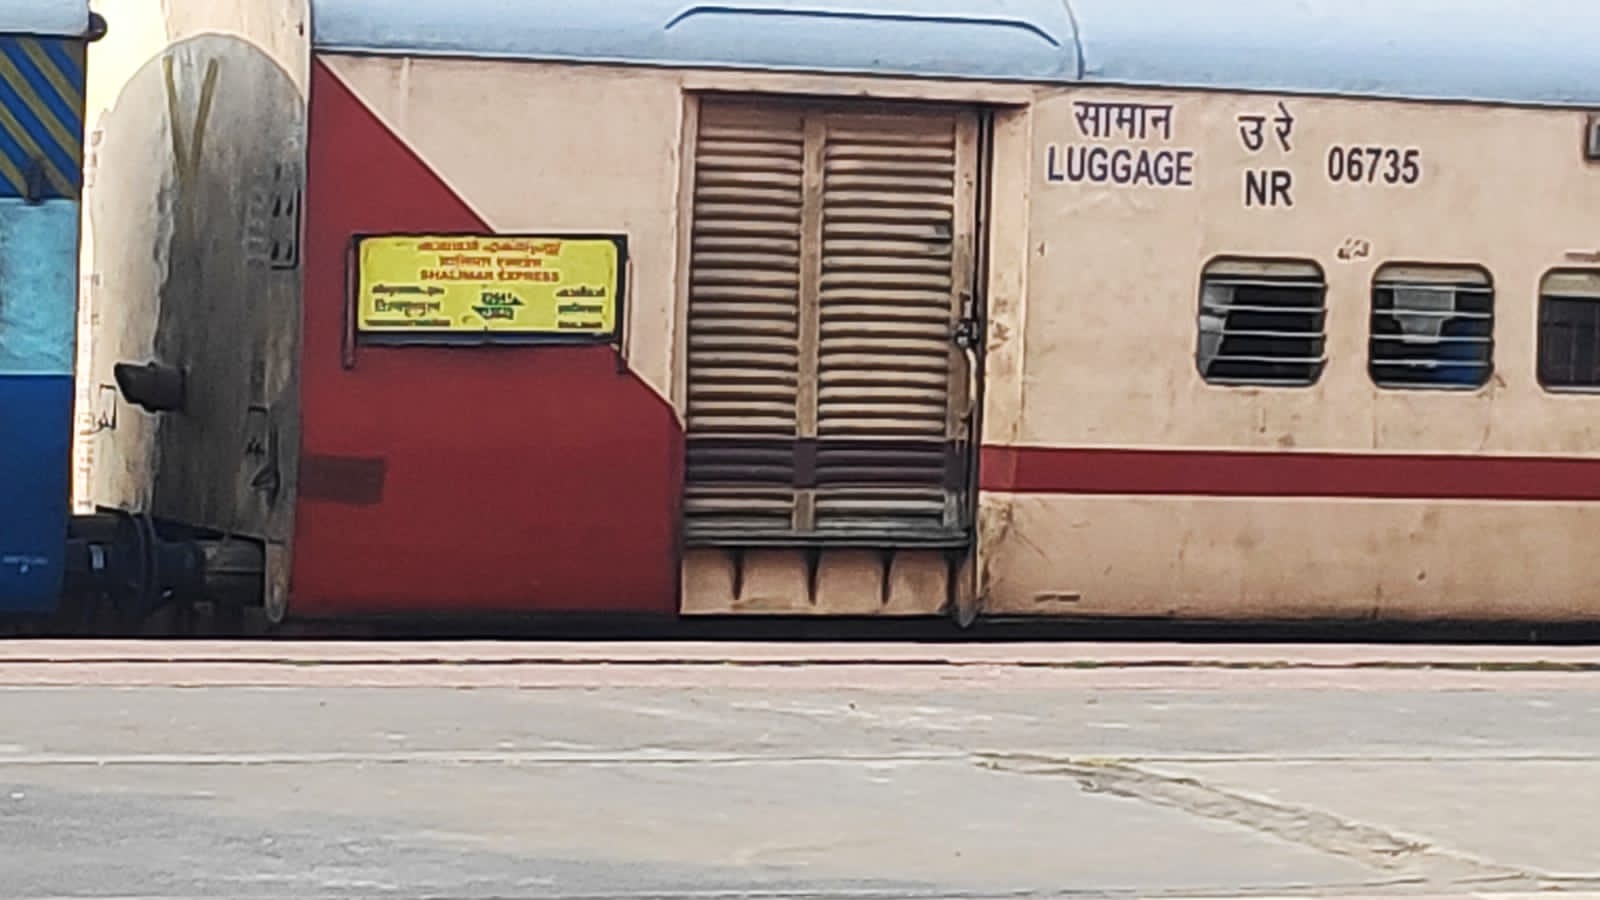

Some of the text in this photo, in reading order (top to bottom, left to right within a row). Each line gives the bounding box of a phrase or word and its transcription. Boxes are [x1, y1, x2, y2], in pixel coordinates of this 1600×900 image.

[1074, 102, 1172, 139] सामान
[1238, 103, 1295, 152] उ रे
[1047, 145, 1194, 186] LUGGAGE
[1327, 145, 1421, 184] 06735
[1245, 171, 1294, 207] NR
[497, 269, 560, 282] EXPRESS
